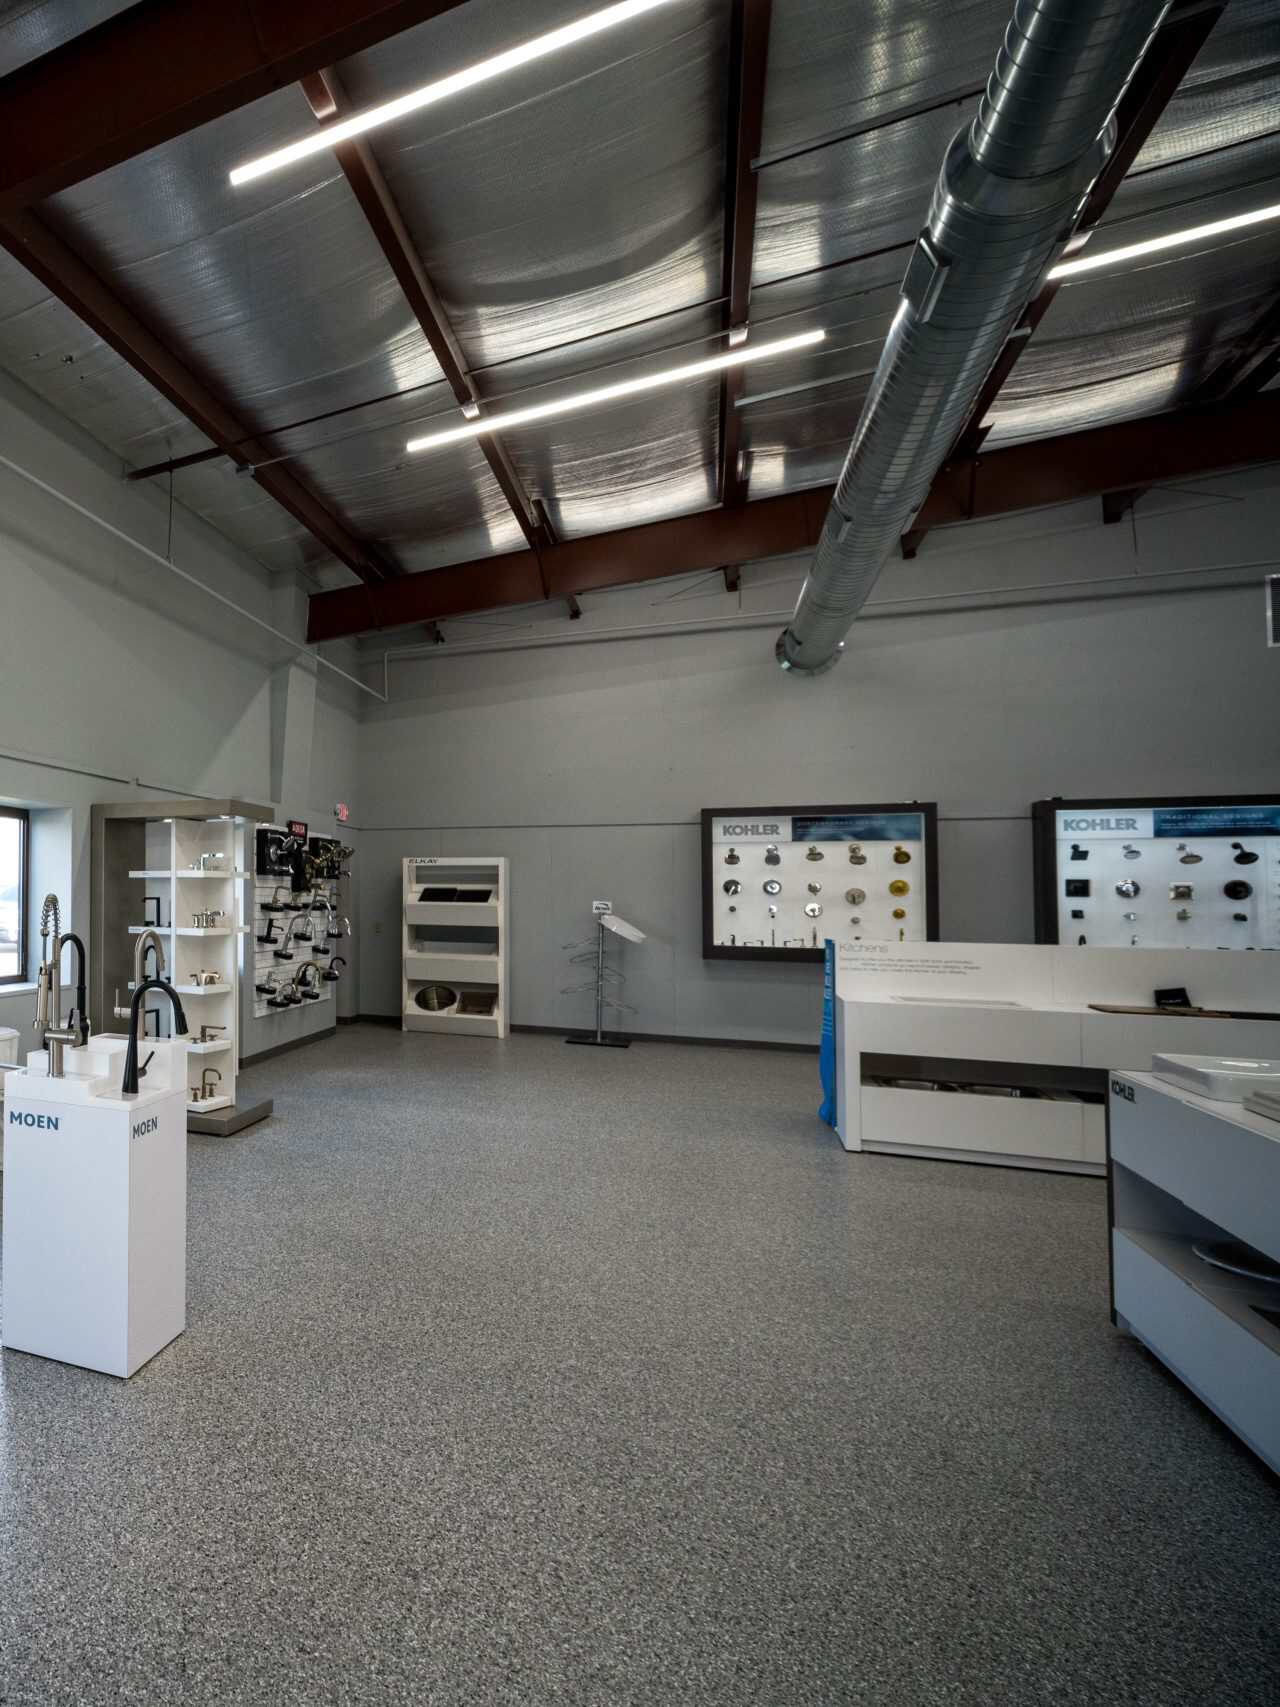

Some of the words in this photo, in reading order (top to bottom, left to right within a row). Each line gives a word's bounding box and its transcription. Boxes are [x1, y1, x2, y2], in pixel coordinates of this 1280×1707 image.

[722, 824, 780, 836] KOHLER
[1063, 817, 1138, 832] KOHLER
[1111, 1079, 1137, 1104] KOHLER
[9, 1111, 60, 1131] MOEN
[132, 1116, 159, 1140] MOEN
